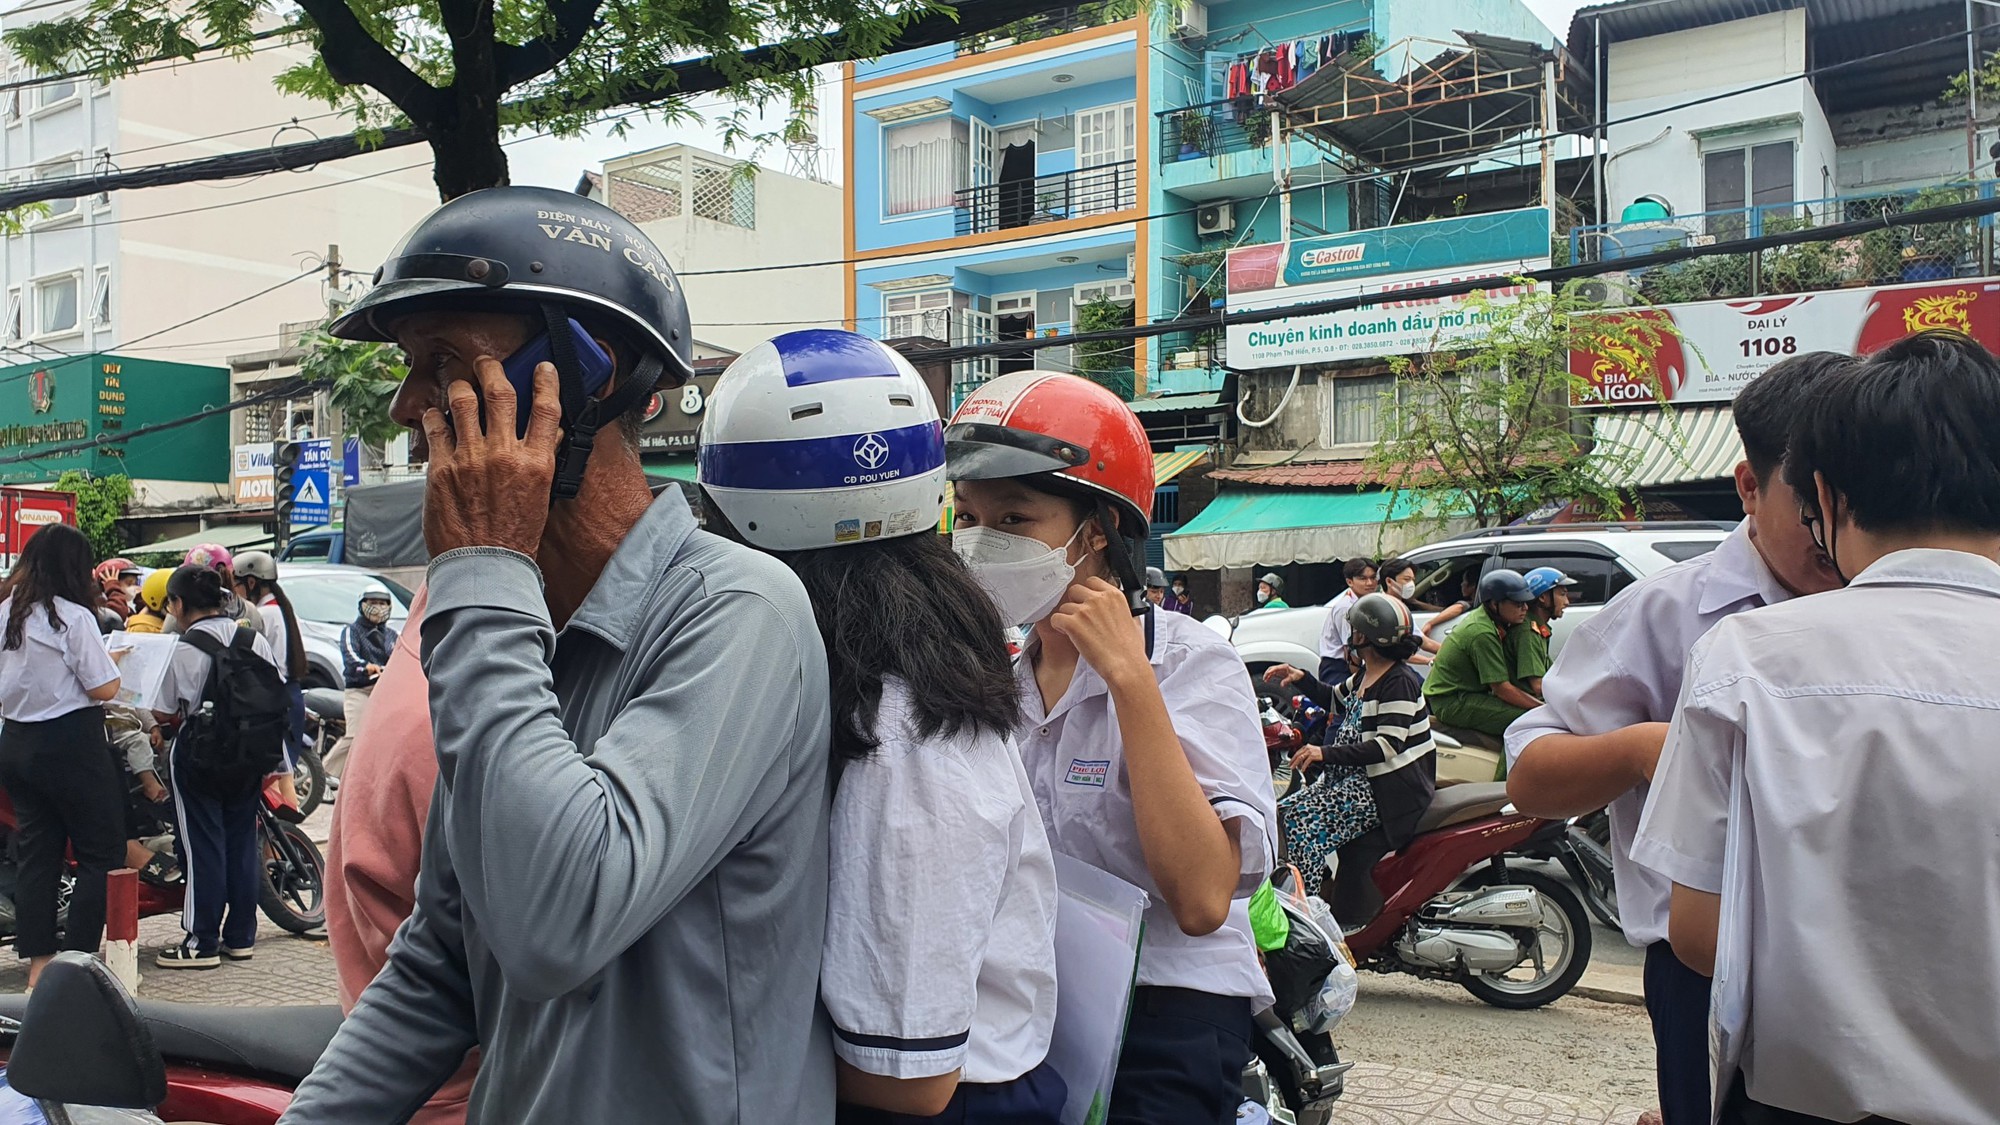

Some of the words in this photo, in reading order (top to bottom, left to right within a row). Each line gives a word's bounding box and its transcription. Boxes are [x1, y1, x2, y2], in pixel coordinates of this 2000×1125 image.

[537, 210, 576, 223] ĐIỆN
[581, 216, 612, 233] MÁY
[624, 234, 646, 252] NỘI
[538, 224, 613, 252] VĂN
[623, 247, 675, 292] CAO
[1316, 246, 1360, 264] Castrol
[1248, 328, 1304, 347] Chuyên
[1309, 322, 1343, 341] kinh
[1348, 317, 1397, 337] doanh
[1401, 311, 1433, 331] dầu
[1748, 318, 1769, 332] ĐẠI
[1773, 315, 1788, 328] LÝ
[1739, 336, 1797, 357] 1108
[1604, 373, 1628, 384] BIA
[1728, 371, 1757, 381] NƯỚC
[250, 452, 274, 467] Vilu
[860, 473, 878, 483] POU
[879, 469, 900, 481] YUEN
[239, 479, 274, 498] MOTU
[1481, 818, 1537, 837] VISION
